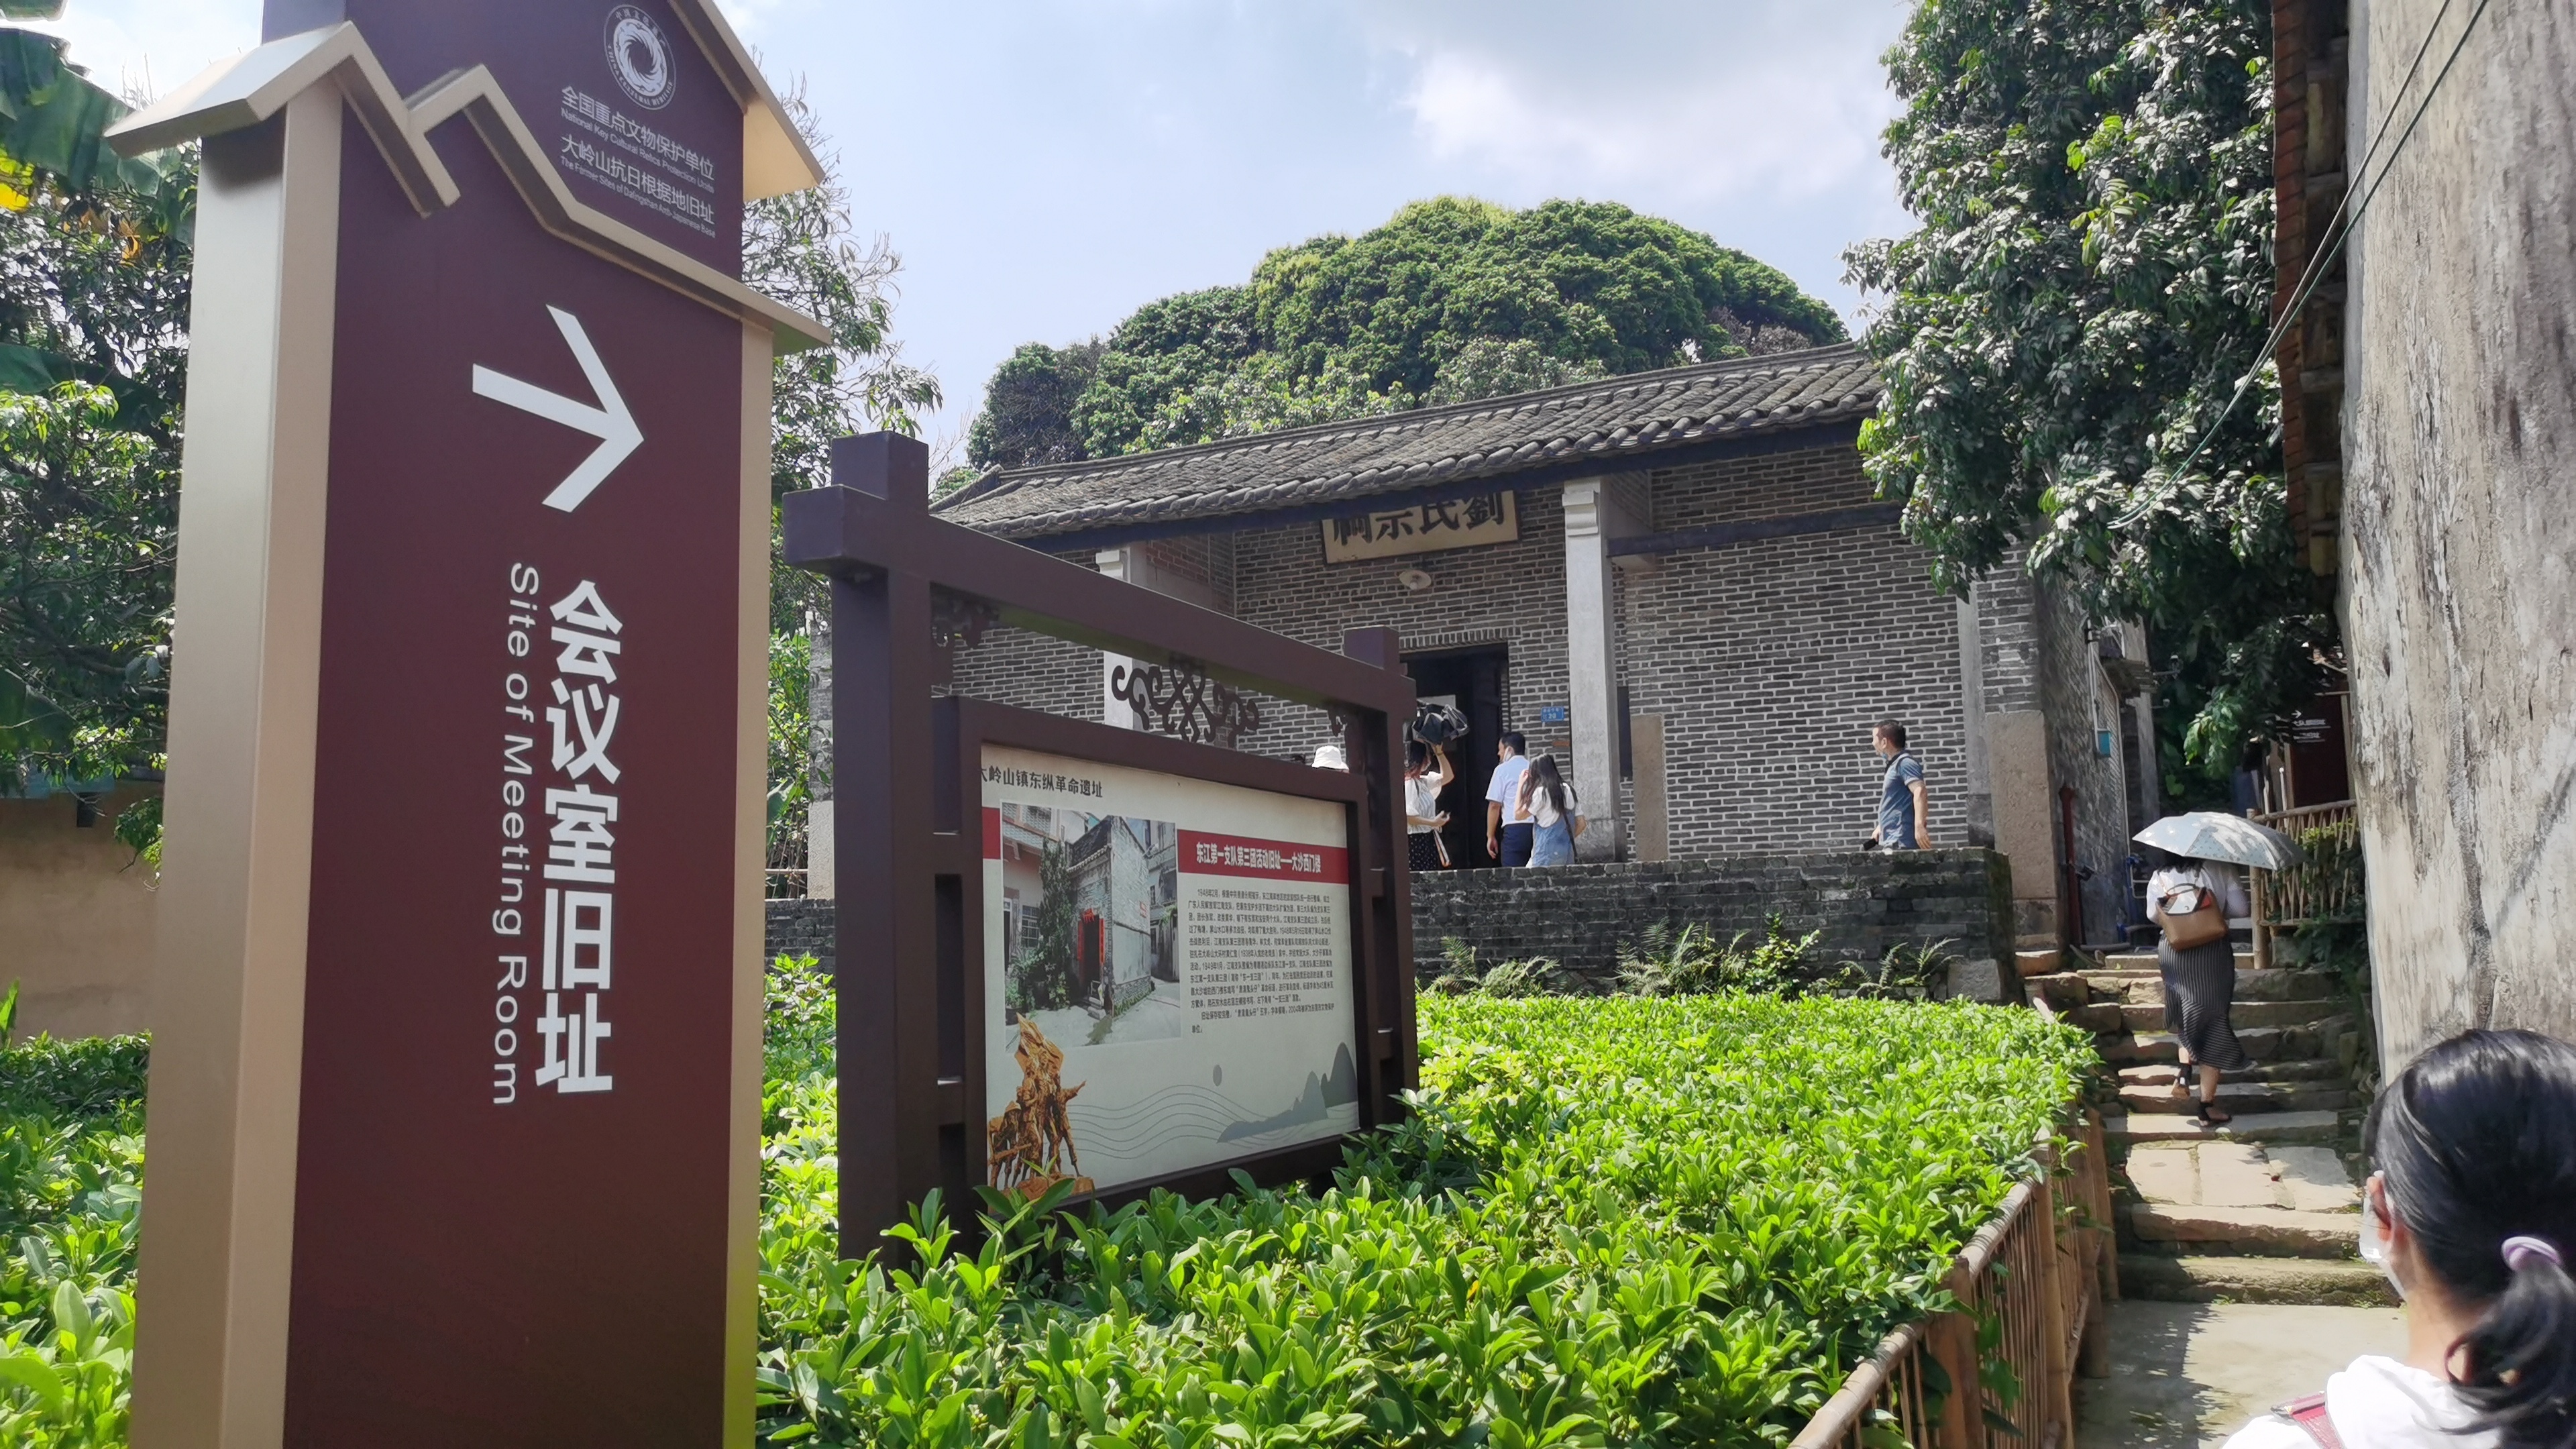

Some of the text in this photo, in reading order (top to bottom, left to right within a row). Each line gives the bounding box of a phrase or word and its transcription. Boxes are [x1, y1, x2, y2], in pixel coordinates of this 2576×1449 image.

[561, 107, 593, 131] National
[594, 124, 608, 142] Key
[561, 85, 714, 180] 全国重点文物保护单位
[561, 134, 715, 225] 大岭山抗日根据地旧址
[492, 562, 539, 1106] Site of Meeting Room
[536, 579, 623, 1093] 会议室旧址
